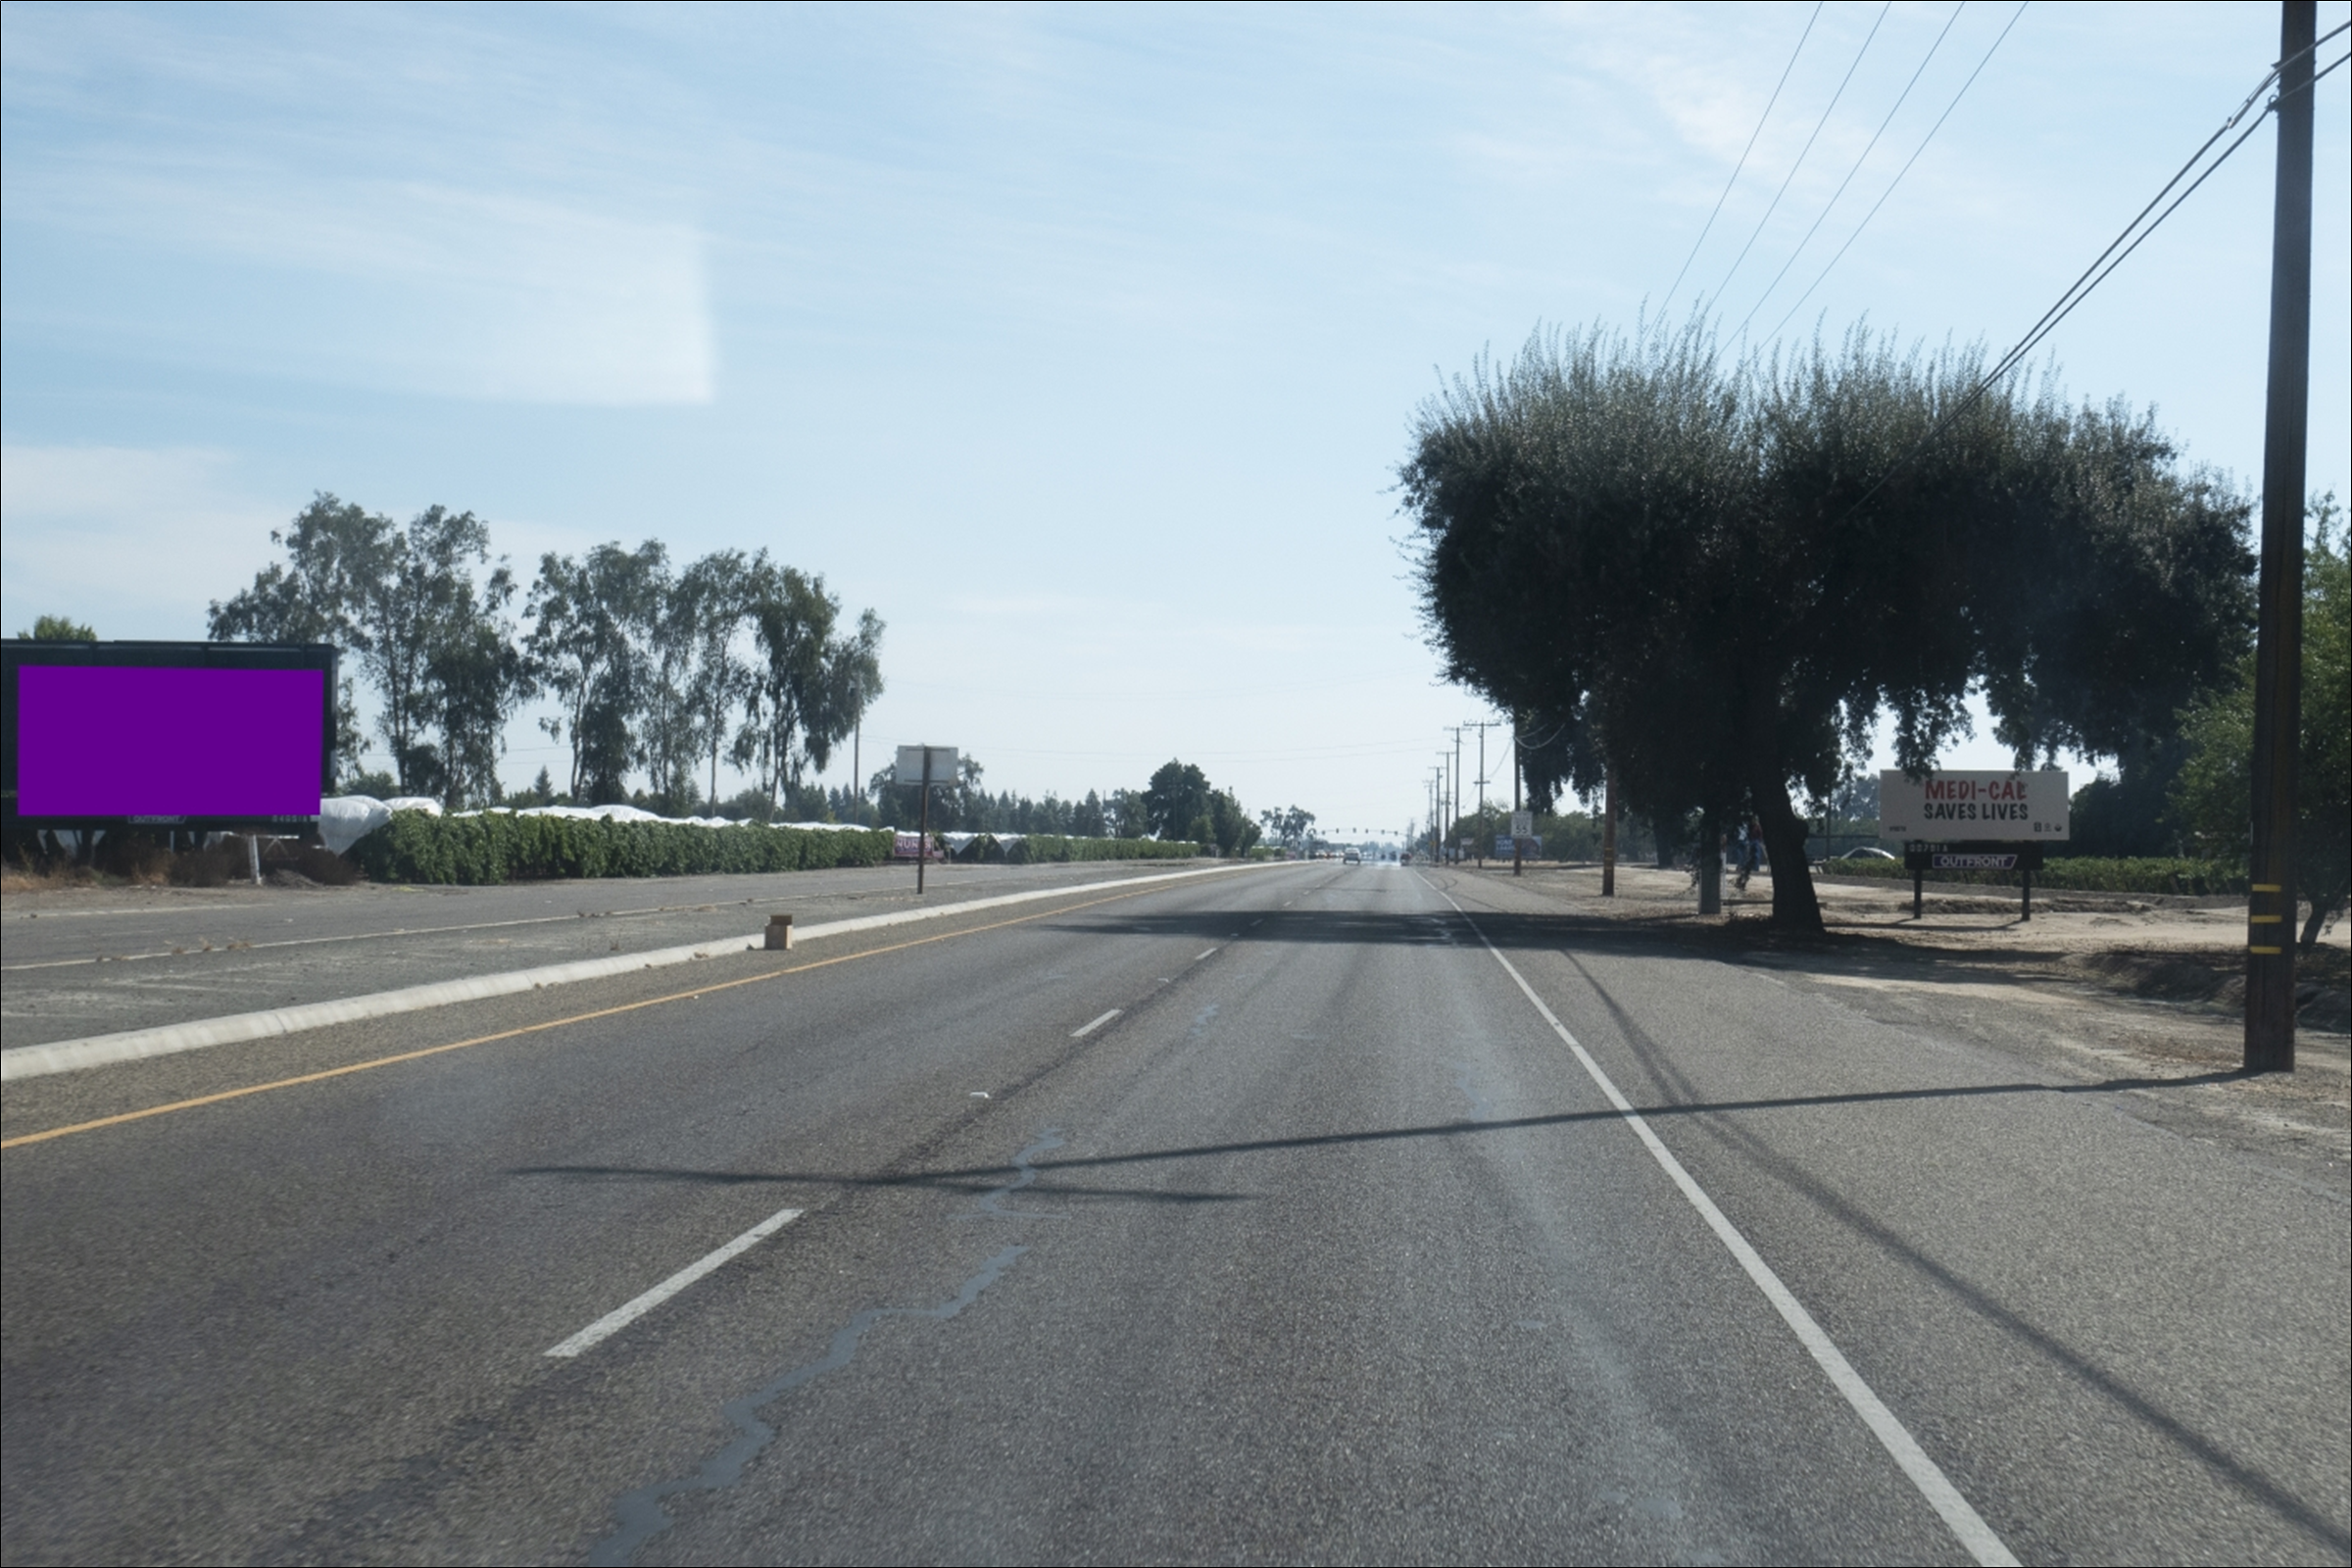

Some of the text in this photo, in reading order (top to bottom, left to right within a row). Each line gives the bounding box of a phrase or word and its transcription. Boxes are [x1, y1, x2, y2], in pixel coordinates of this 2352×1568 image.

[1925, 780, 2028, 800] MEDI-CAL
[1924, 803, 2029, 820] SAVES LIVES
[1516, 824, 1529, 834] 55
[1940, 856, 2008, 867] OUTFRONT
